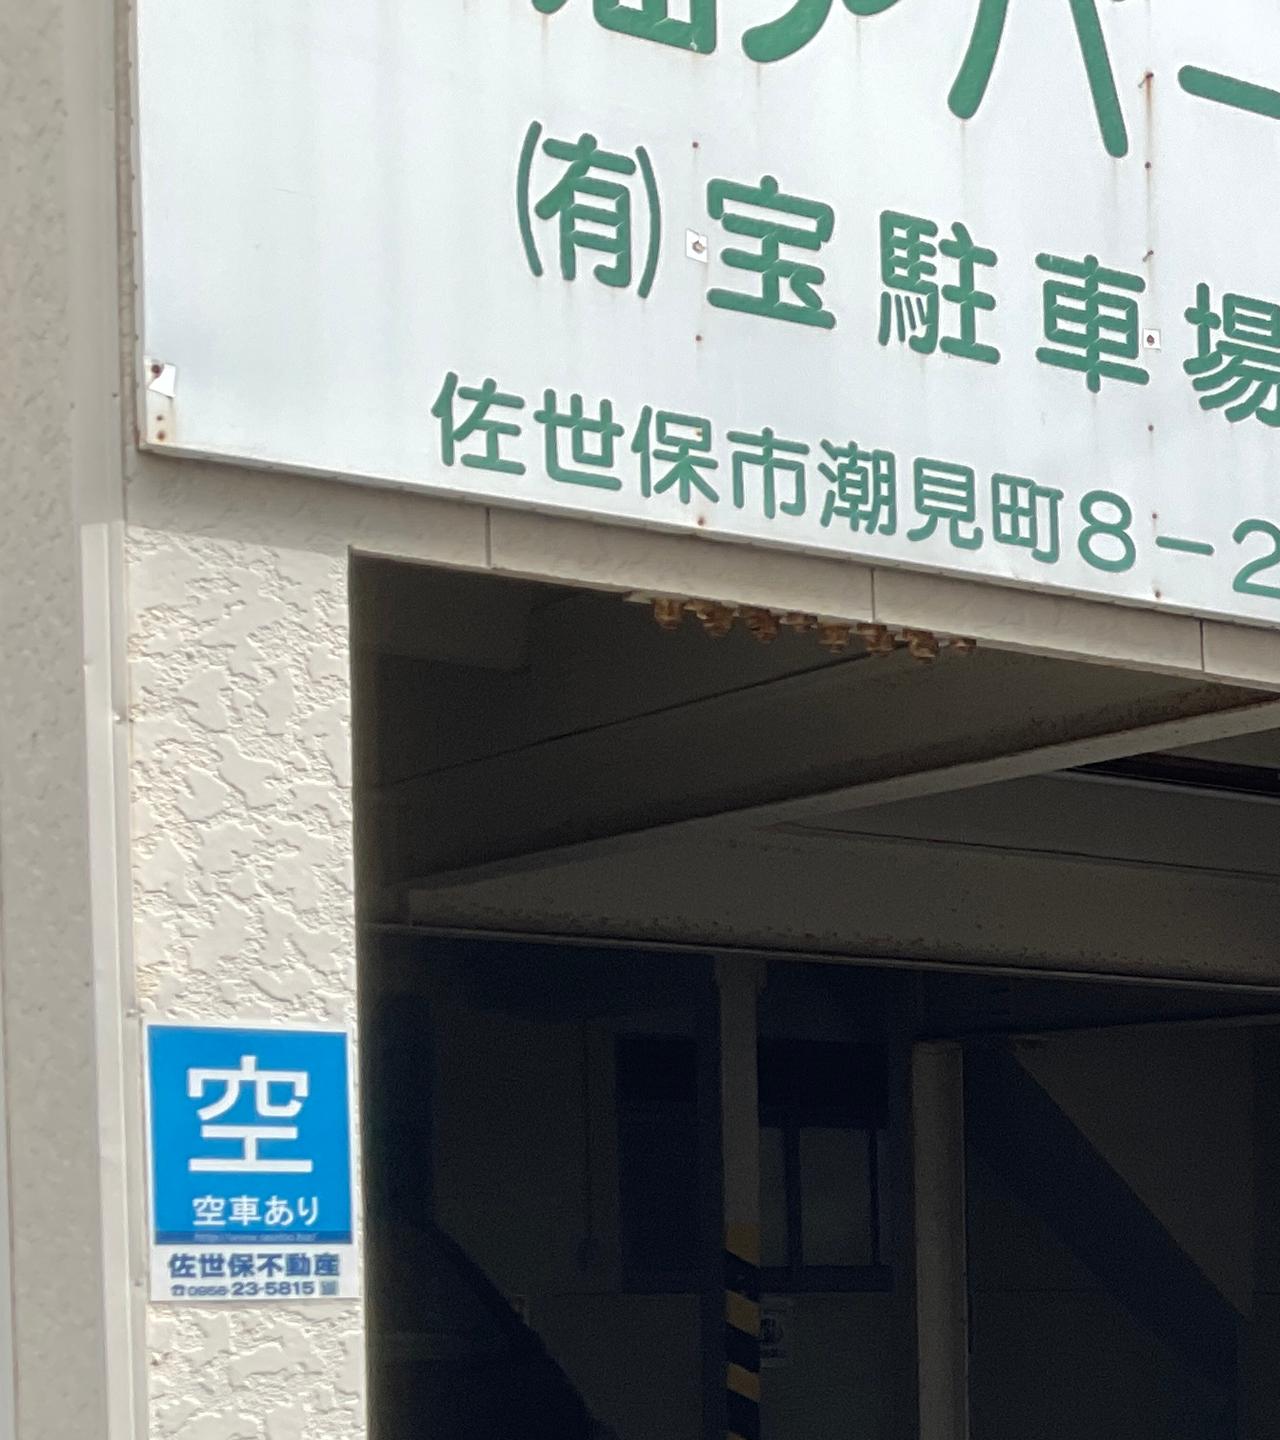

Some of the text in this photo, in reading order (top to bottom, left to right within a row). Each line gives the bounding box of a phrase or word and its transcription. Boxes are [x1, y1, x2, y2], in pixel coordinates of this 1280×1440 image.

[187, 1055, 313, 1173] 空
[191, 1195, 319, 1226] 空車あり
[168, 1252, 340, 1279] 佐世保不動産
